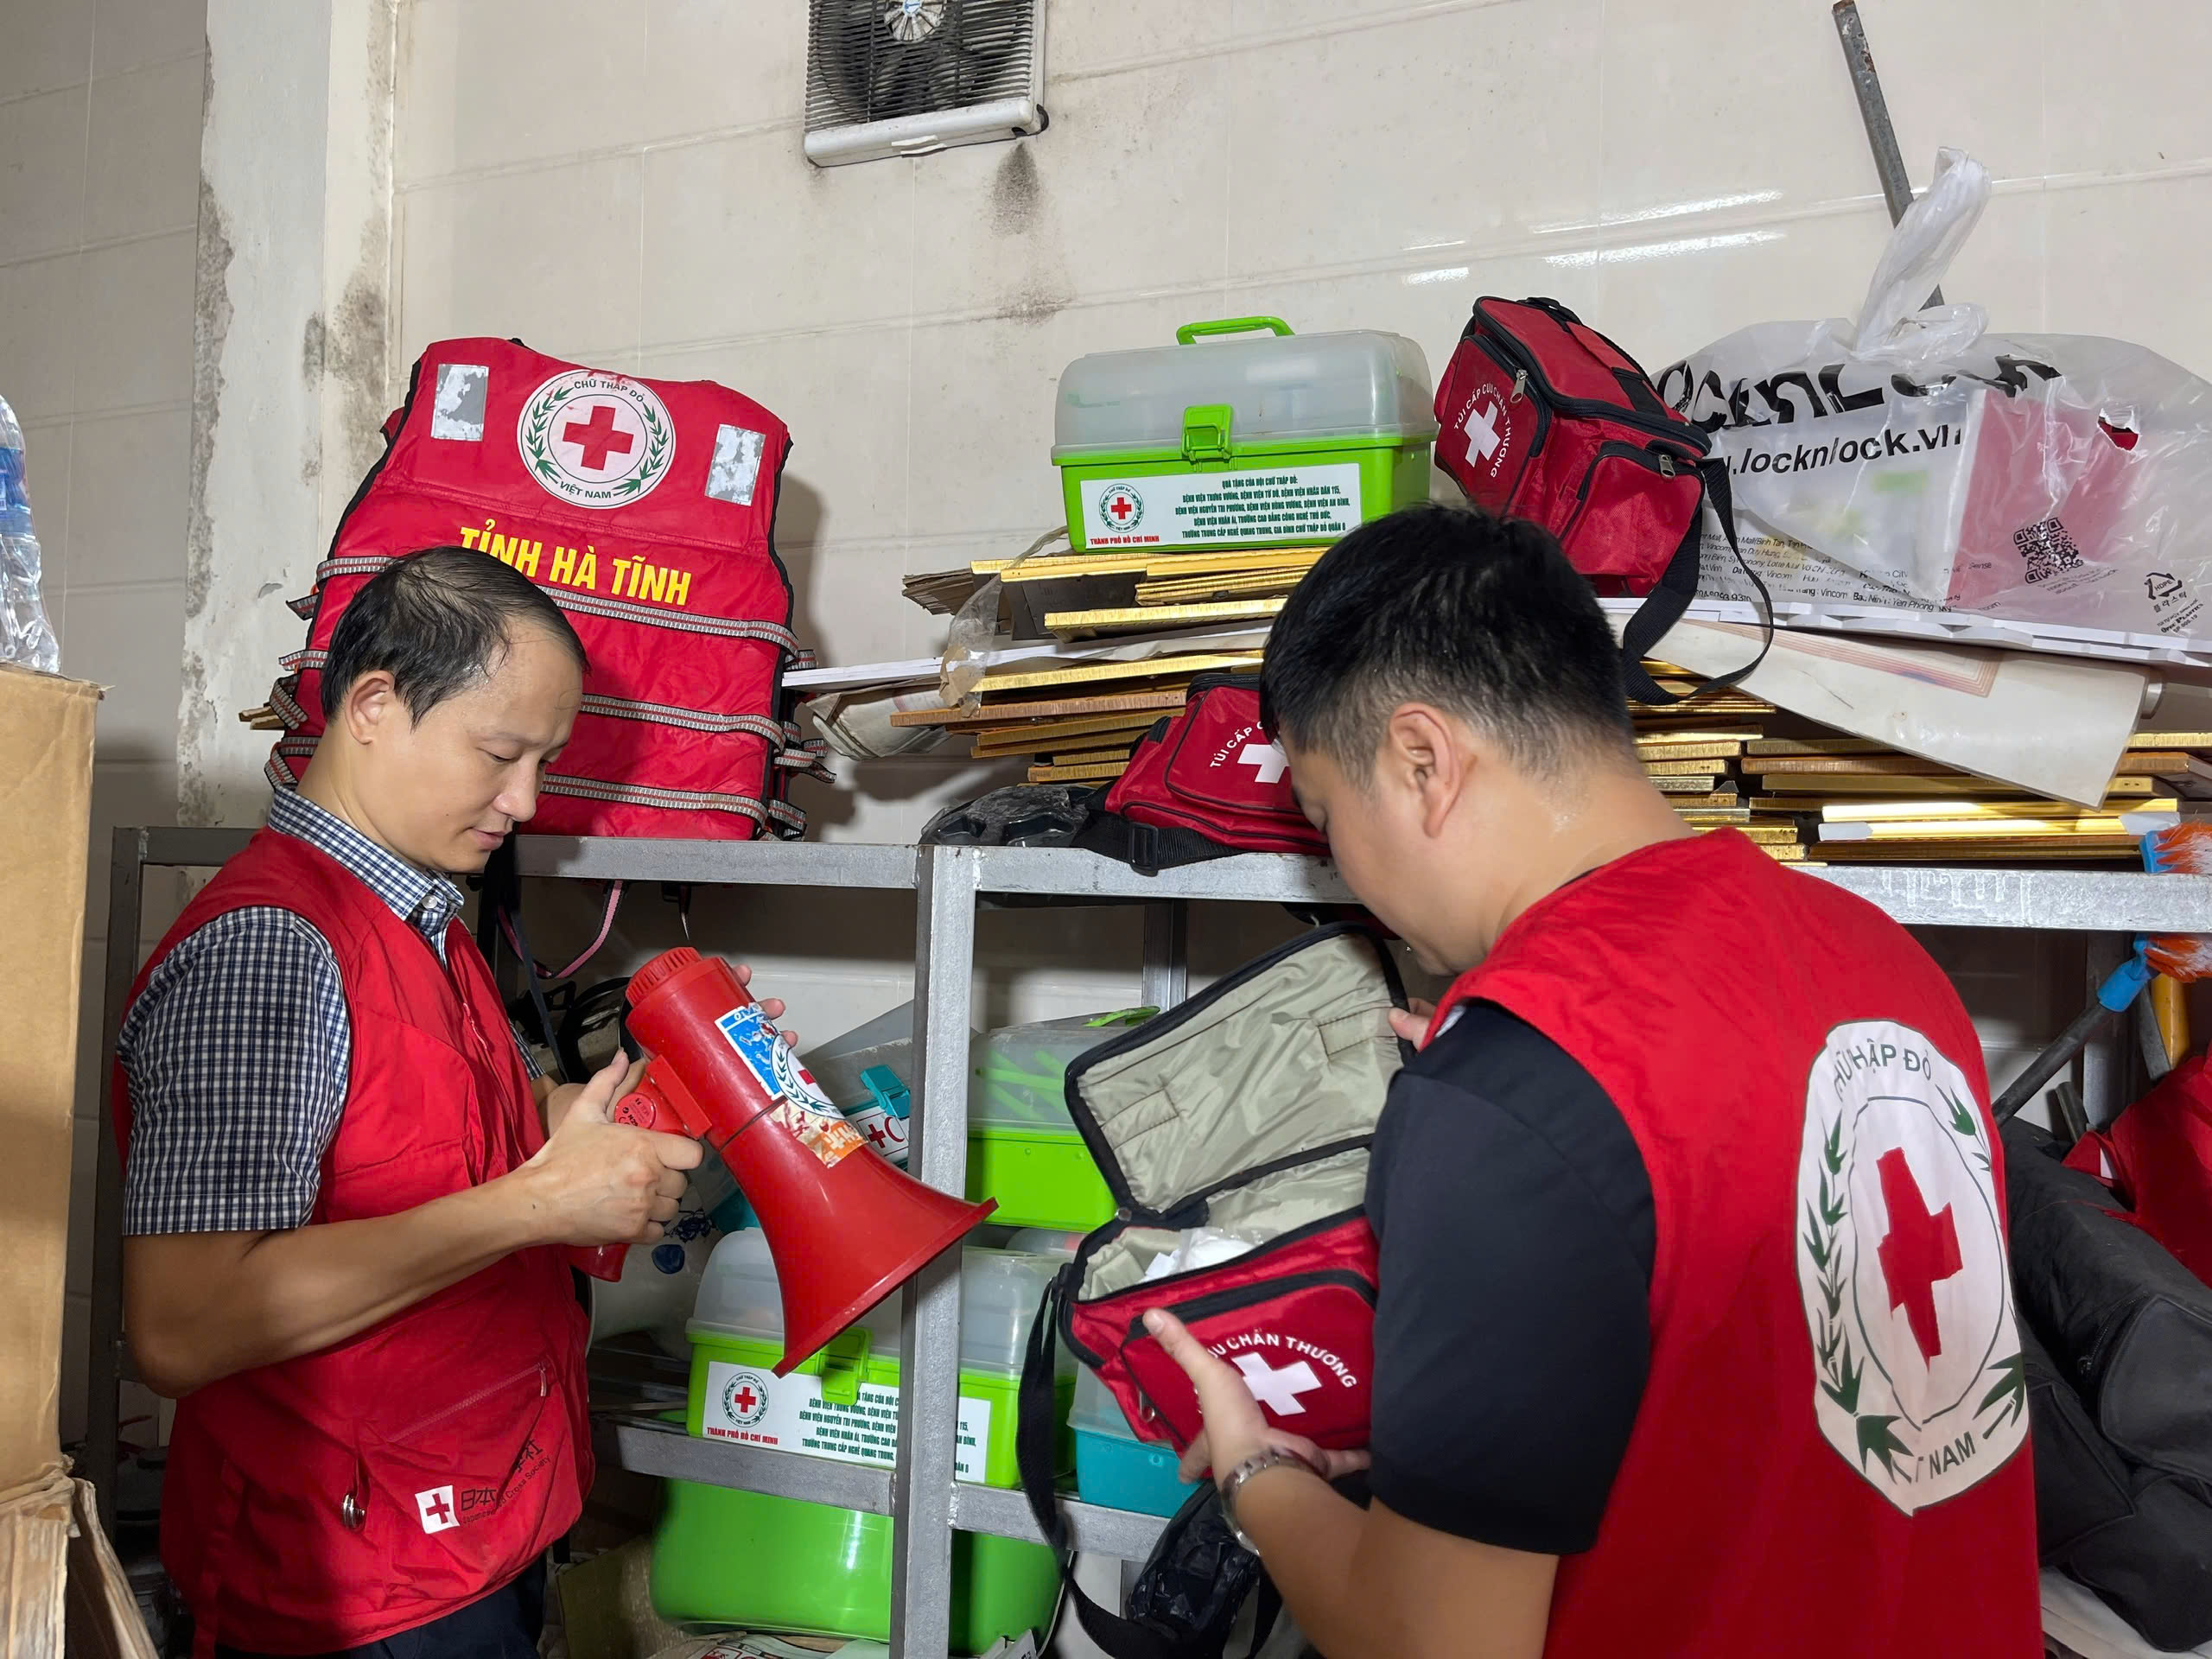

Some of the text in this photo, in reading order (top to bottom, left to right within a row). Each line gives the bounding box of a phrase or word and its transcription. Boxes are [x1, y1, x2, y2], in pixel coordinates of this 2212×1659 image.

[574, 378, 597, 389] CHỮ
[560, 481, 612, 499] VIỆT NAM
[1110, 535, 1122, 544] PHỐ
[549, 544, 597, 591] HÀ
[611, 555, 692, 606] TĨNH
[2154, 580, 2173, 591] HDPE
[1210, 727, 1252, 767] TÚI CẤP
[1847, 1038, 1897, 1073] HẬP
[1903, 1049, 1931, 1081] ĐỎ
[1286, 1336, 1357, 1388] THƯƠNG
[707, 1426, 726, 1437] THÀNH
[728, 1429, 739, 1439] PHỐ
[762, 1435, 778, 1445] MINH
[1929, 1431, 1976, 1479] NAM
